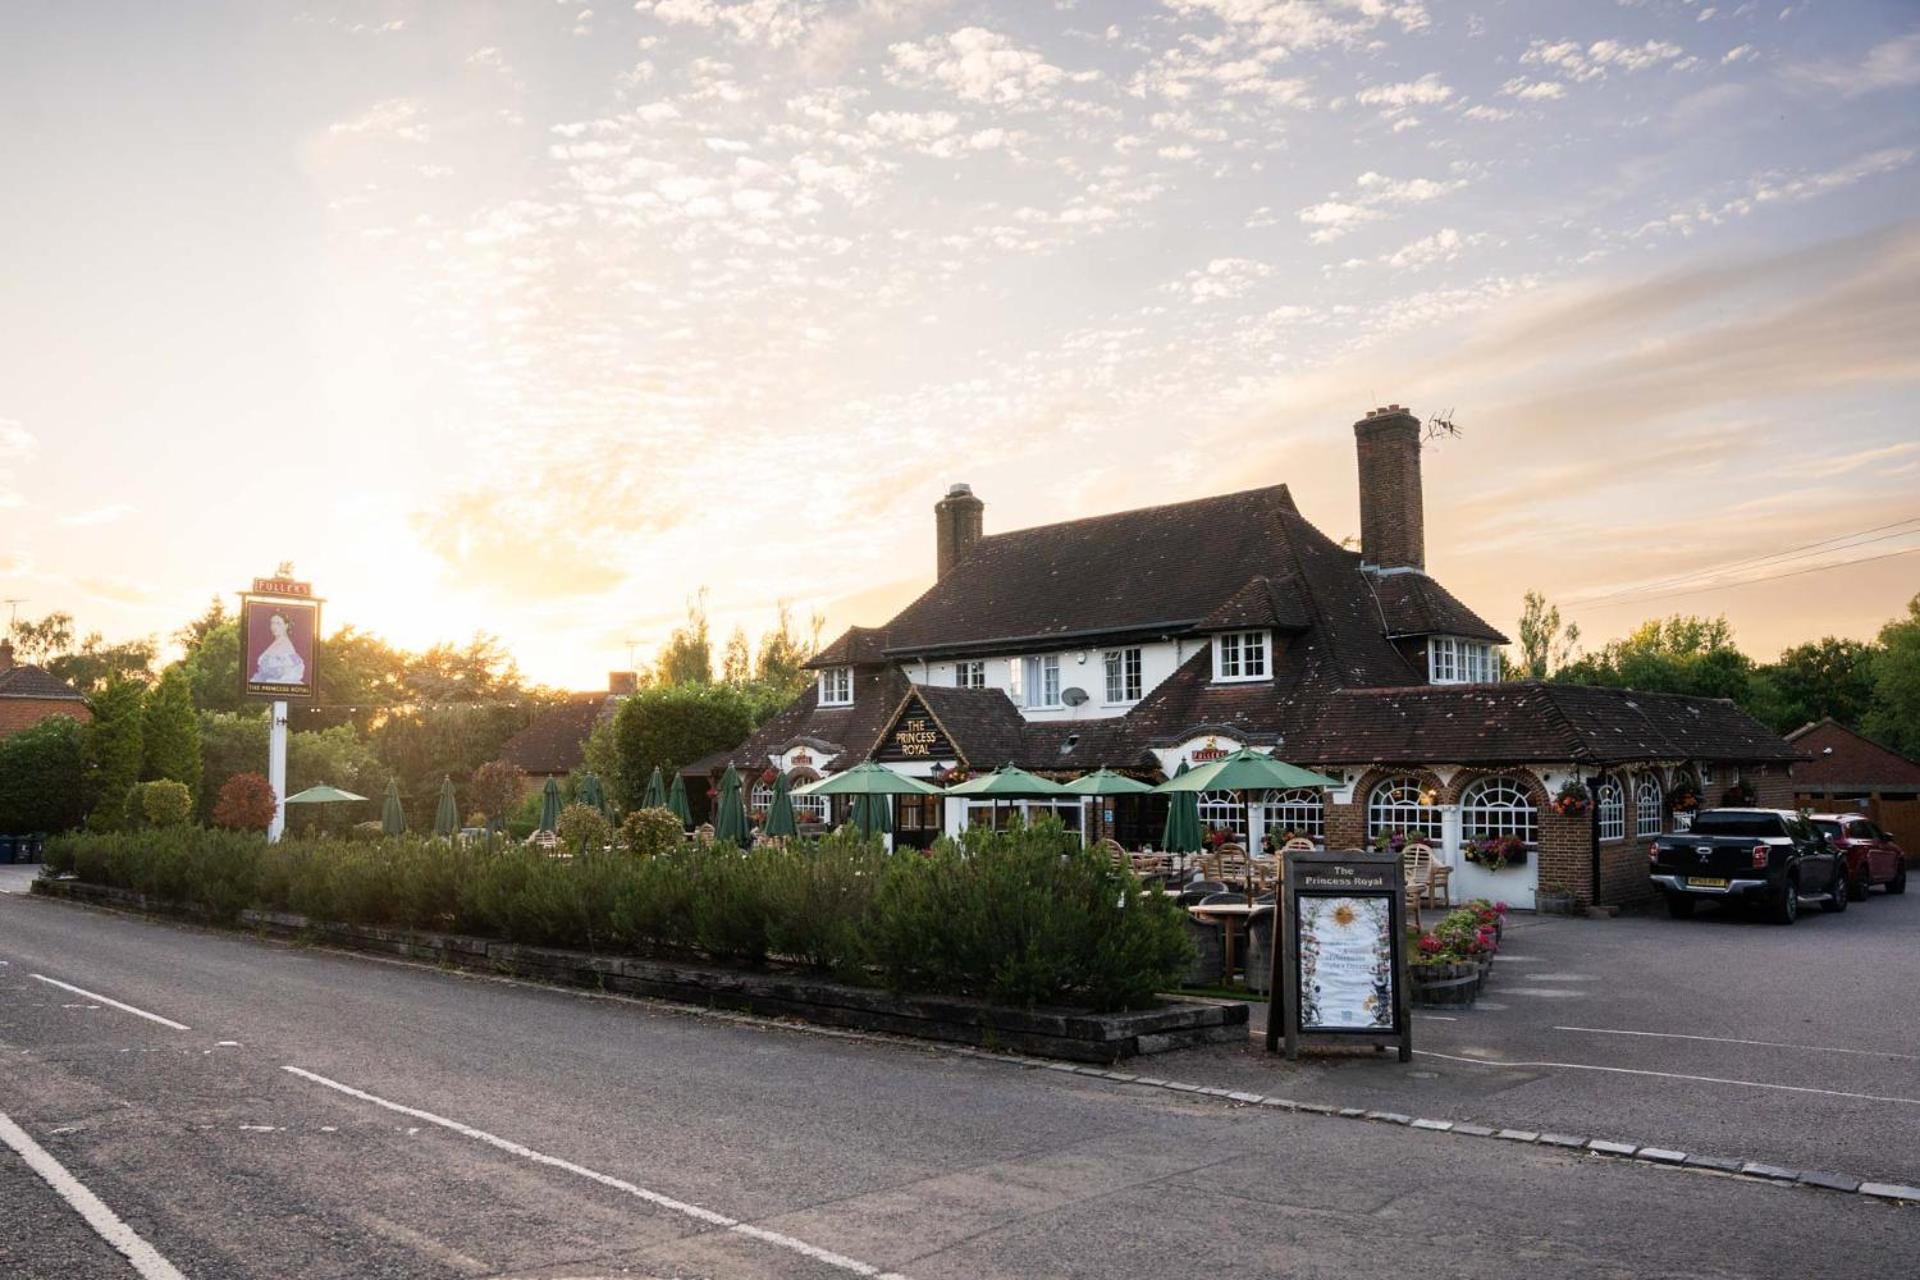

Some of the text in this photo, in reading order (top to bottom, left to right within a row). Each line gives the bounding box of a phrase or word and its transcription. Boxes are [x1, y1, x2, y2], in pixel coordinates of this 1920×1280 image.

[907, 720, 925, 731] THE
[896, 732, 936, 744] PRINCESS
[902, 744, 930, 755] ROYAL
[1334, 866, 1354, 875] The
[1305, 876, 1383, 887] Princess Royal
